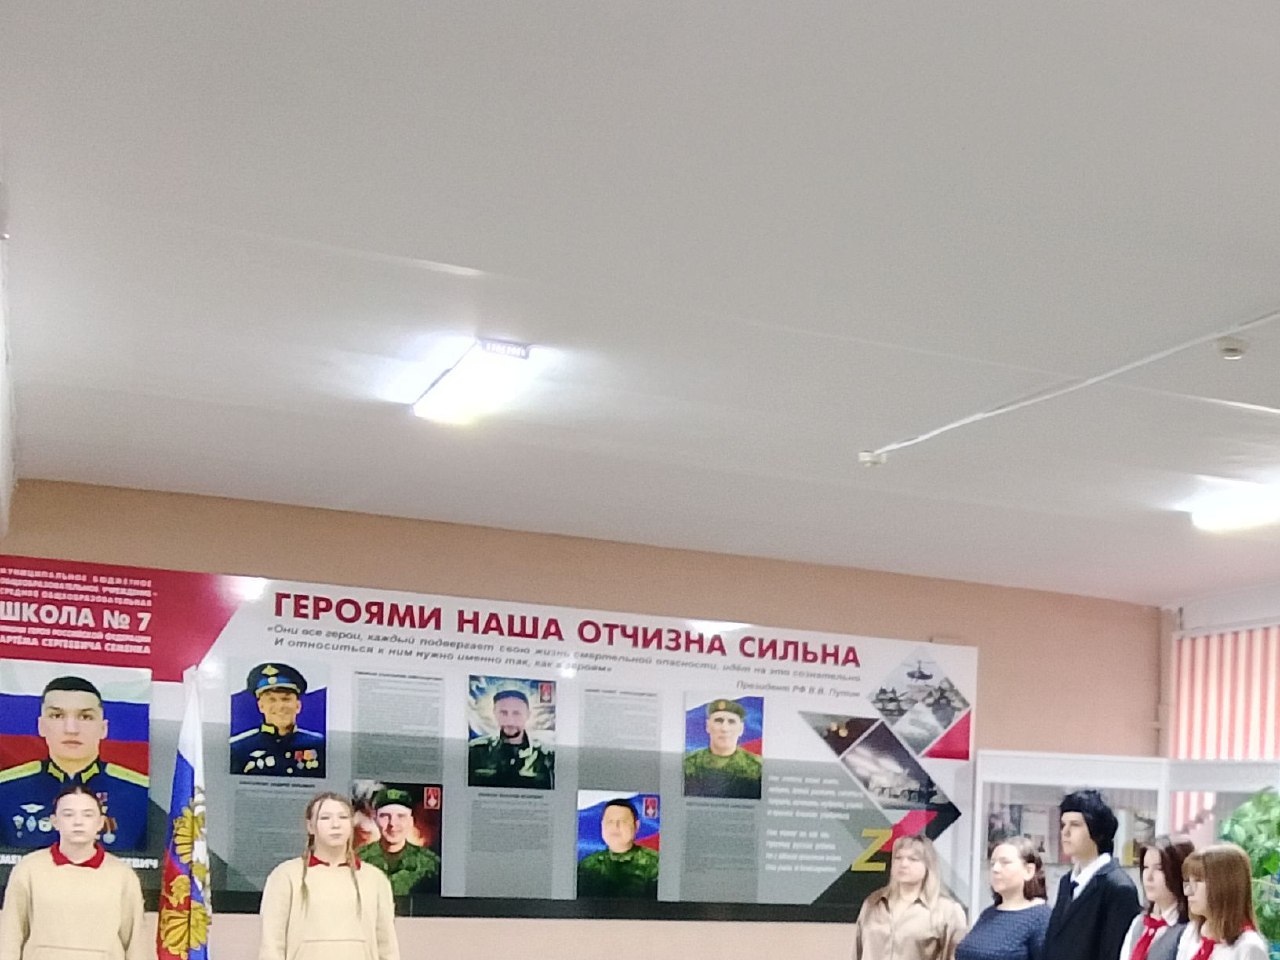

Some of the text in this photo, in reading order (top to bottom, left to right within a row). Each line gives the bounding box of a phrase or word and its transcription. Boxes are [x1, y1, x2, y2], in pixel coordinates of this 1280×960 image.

[0, 600, 152, 632] ШКОЛА № 7
[274, 592, 861, 668] ГЕРОЯМИ НАША ОТЧИЗНА СИЛЬНА
[850, 828, 893, 872] Z
